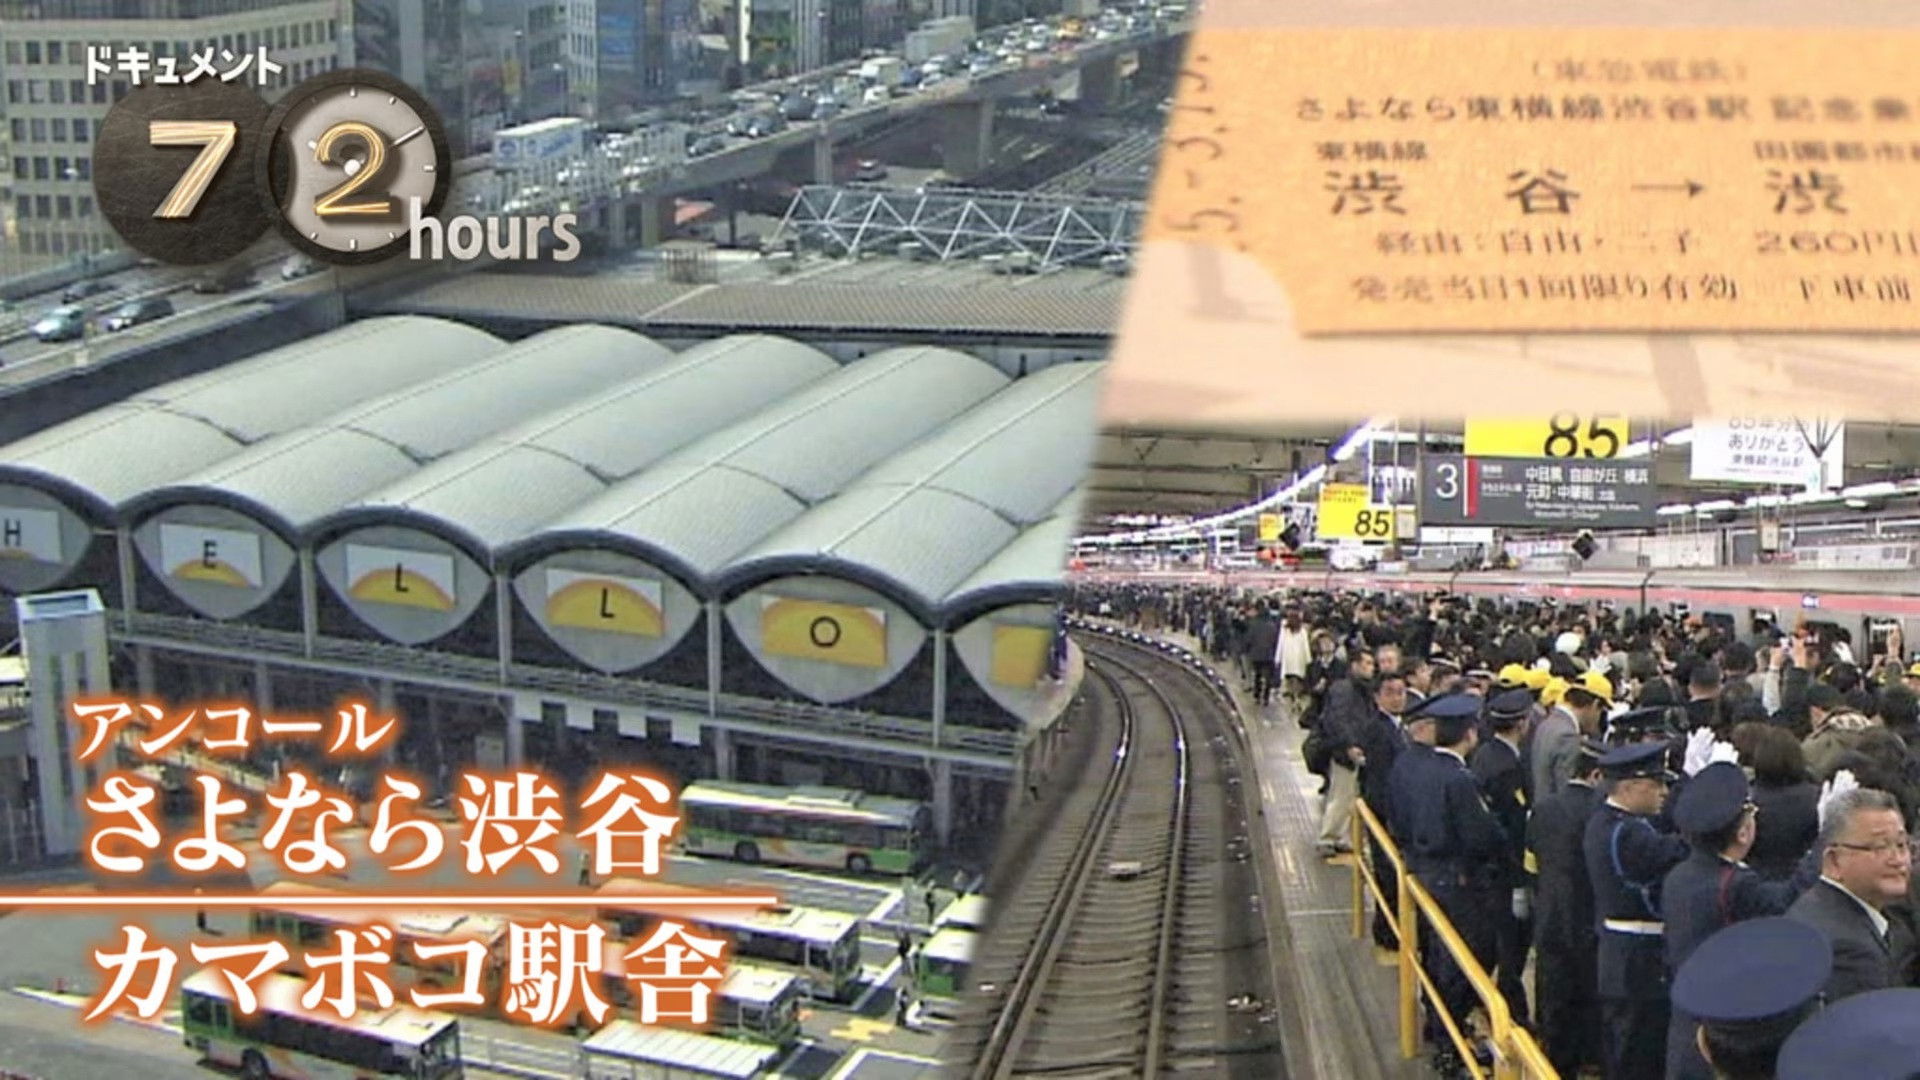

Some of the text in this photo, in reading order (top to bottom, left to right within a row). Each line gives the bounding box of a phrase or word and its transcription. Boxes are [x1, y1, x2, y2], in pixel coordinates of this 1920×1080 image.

[1771, 97, 1920, 121] 記念乗
[1544, 414, 1620, 458] 85
[1728, 433, 1805, 453] ありがとう
[1436, 464, 1458, 499] 3
[1354, 511, 1390, 536] 85
[4, 518, 841, 648] H E L L O
